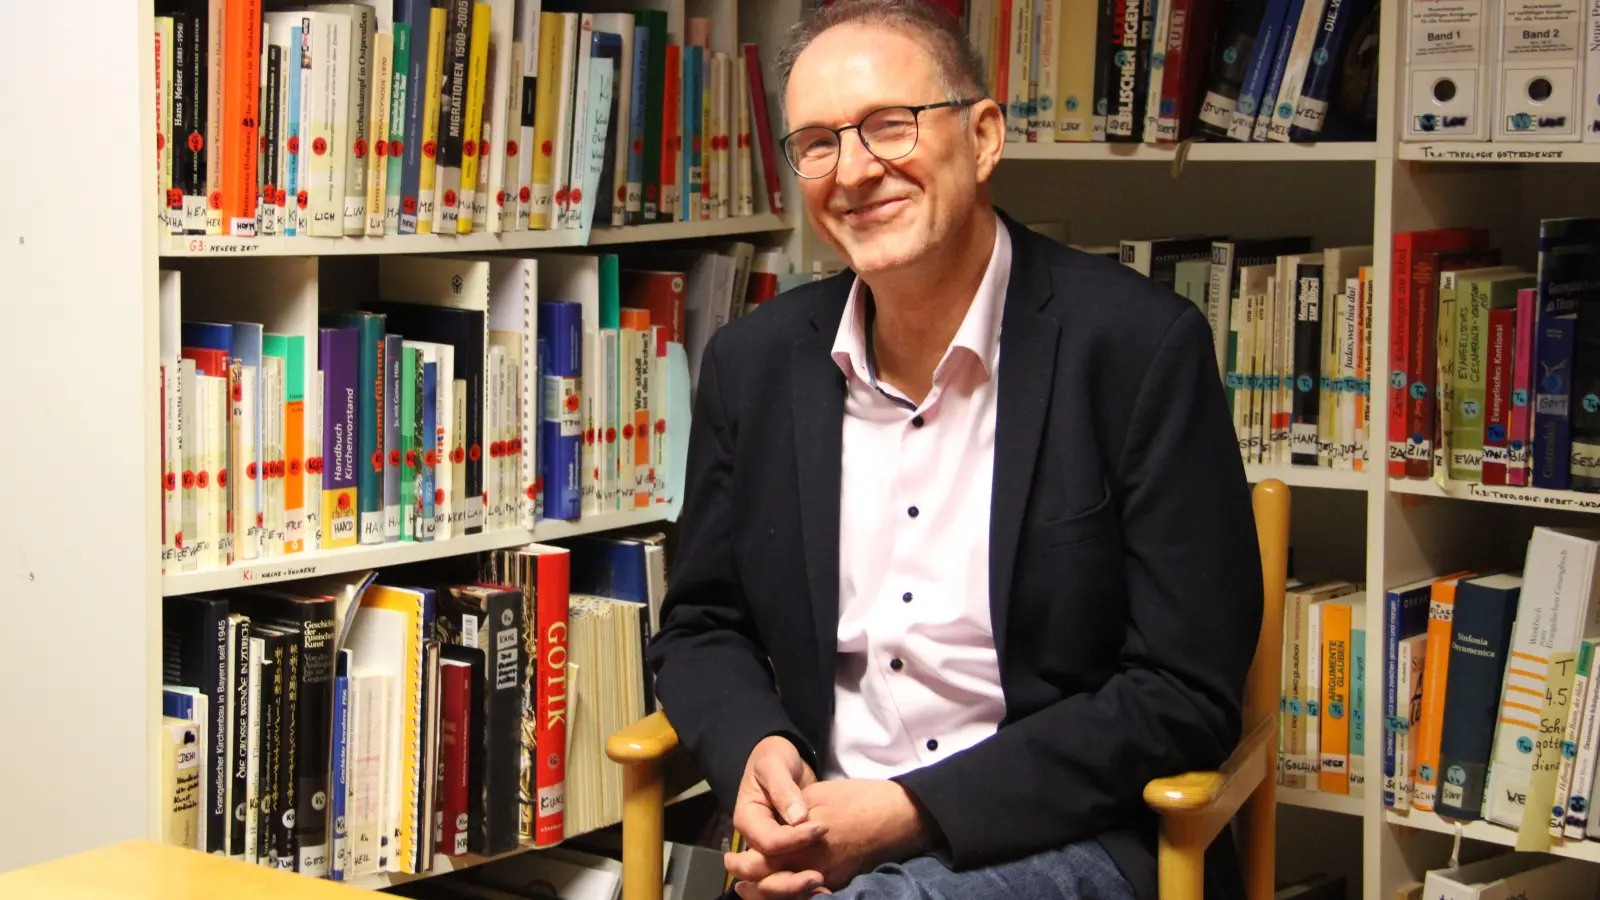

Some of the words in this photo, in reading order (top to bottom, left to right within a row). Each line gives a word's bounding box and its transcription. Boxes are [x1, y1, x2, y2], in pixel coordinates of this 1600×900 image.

[1324, 10, 1338, 32] DIE
[359, 12, 368, 65] Ostpreußen
[1427, 32, 1453, 42] Band
[1456, 31, 1460, 39] 1
[1523, 30, 1550, 39] Band
[1552, 29, 1559, 38] 2
[175, 69, 183, 99] Meiser
[359, 68, 366, 76] in
[450, 63, 464, 136] MIGRATIONEN
[1203, 102, 1229, 116] STUT
[175, 102, 183, 126] Hans
[1295, 105, 1323, 119] WELT
[1397, 248, 1407, 274] Bibel
[1308, 278, 1319, 303] Bibel
[1397, 278, 1405, 294] zur
[1298, 277, 1308, 321] Handbuch
[1308, 303, 1317, 321] zur
[1346, 304, 1355, 321] bist
[1347, 323, 1355, 340] wer
[1493, 324, 1504, 364] Kantional
[634, 358, 642, 386] stabil
[1491, 366, 1503, 422] Evangelisches
[345, 388, 354, 480] Kirchenvorstand
[333, 423, 343, 481] Handbuch
[334, 523, 353, 533] HAND
[288, 566, 316, 575] ÖKUMENE
[218, 620, 226, 641] 1945
[304, 628, 316, 636] der
[1530, 606, 1543, 646] Werkbuch
[1544, 597, 1560, 650] Evangelischen
[240, 623, 250, 661] ZÜRICH
[304, 640, 324, 648] Kunst
[1457, 631, 1489, 647] Sinfonia
[218, 644, 226, 660] seit
[240, 663, 248, 674] IN
[547, 621, 567, 731] GOTIK
[1328, 640, 1336, 702] ARGUMENTE
[1336, 641, 1344, 688] GLAUBEN
[1555, 658, 1574, 677] T
[217, 662, 227, 692] Bayern
[217, 695, 225, 703] in
[239, 677, 248, 716] WENDE
[1546, 687, 1569, 707] 4.5
[216, 705, 226, 754] Kirchenbau
[239, 717, 248, 757] GROSSE
[236, 760, 247, 778] DIE
[215, 756, 225, 815] Evangelischer
